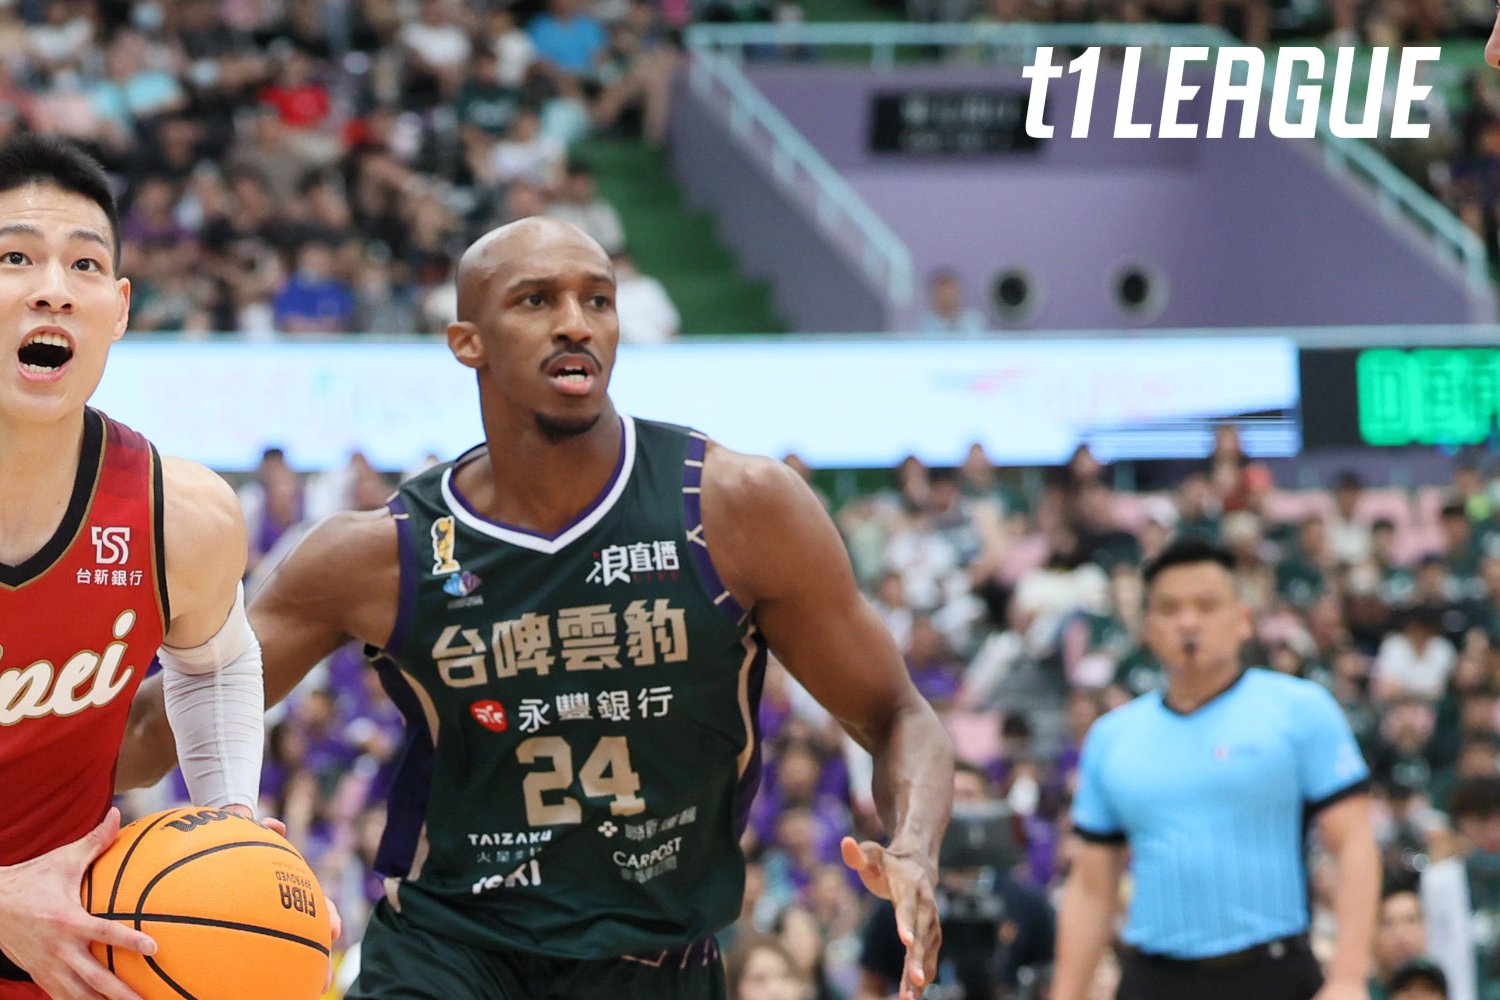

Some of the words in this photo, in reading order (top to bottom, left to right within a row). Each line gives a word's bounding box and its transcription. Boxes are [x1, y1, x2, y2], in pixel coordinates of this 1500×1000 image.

[76, 567, 143, 586] 台新銀行
[585, 541, 680, 586] 浪直播
[431, 598, 688, 689] 台啤雲豹
[518, 686, 674, 733] 永豐銀行
[515, 736, 647, 827] 24
[613, 836, 682, 869] CARPOST
[279, 883, 316, 918] FIBA
